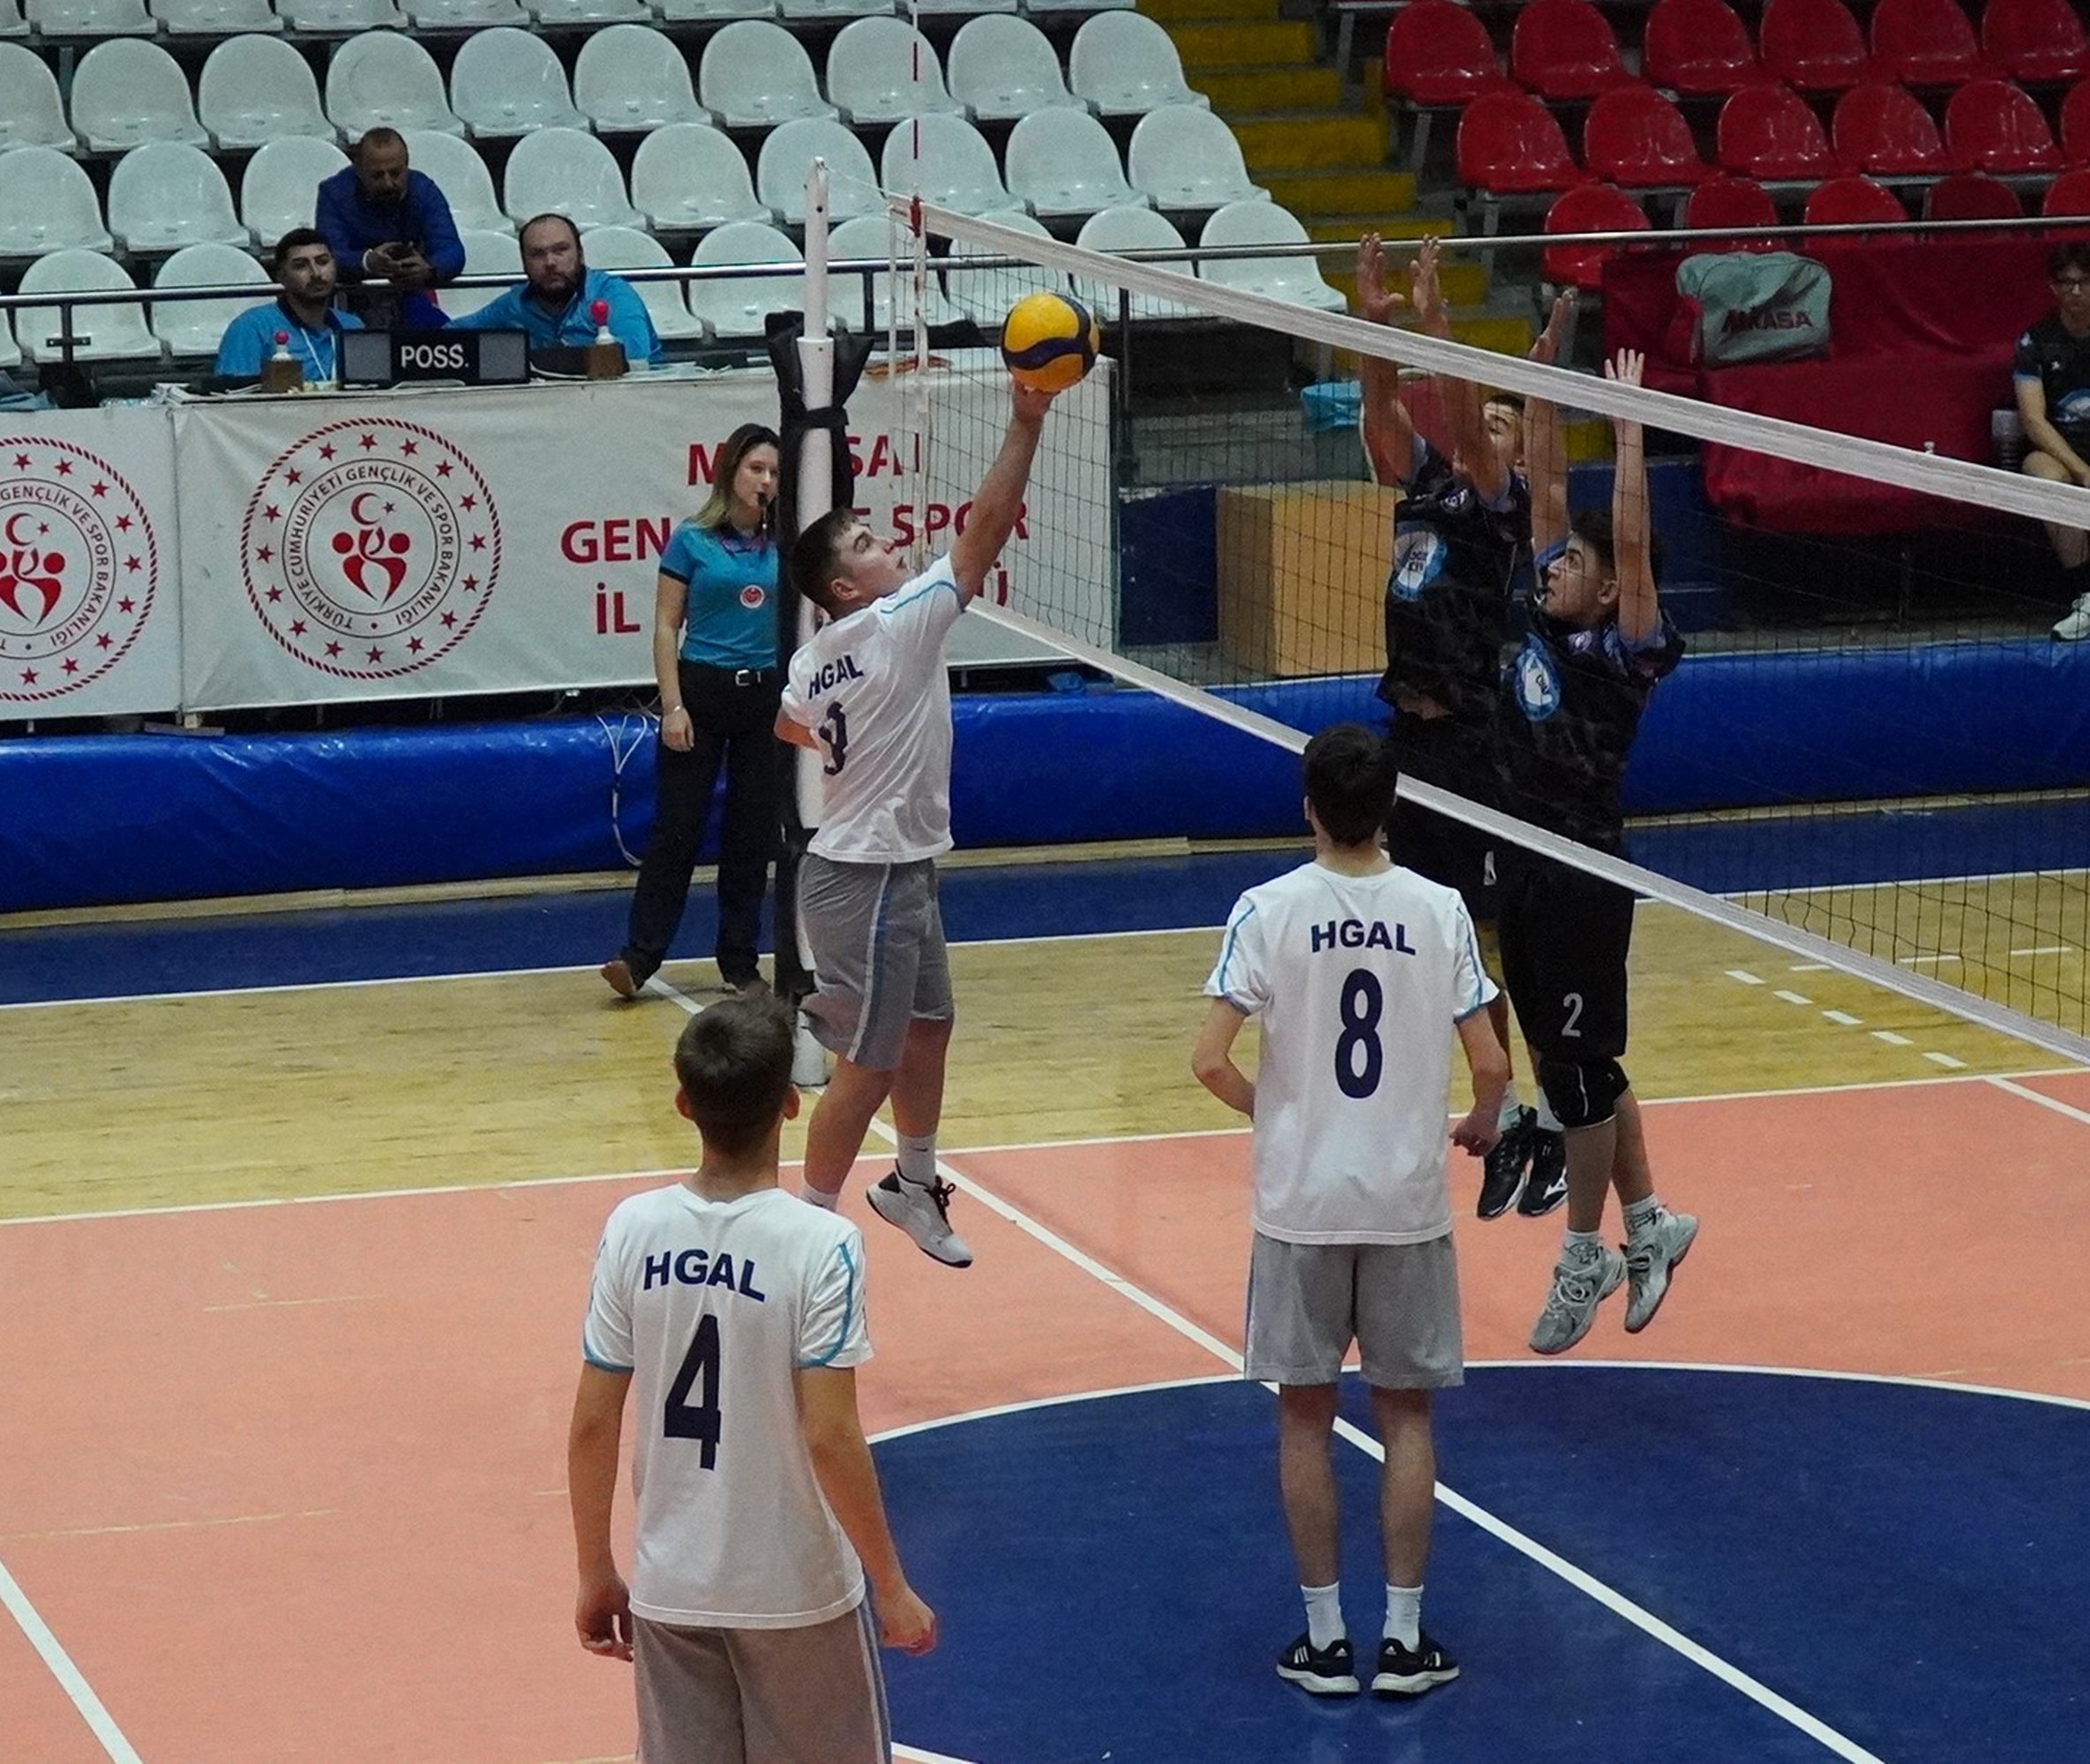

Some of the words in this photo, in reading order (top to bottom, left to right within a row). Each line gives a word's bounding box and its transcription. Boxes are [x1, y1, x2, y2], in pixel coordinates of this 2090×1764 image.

[401, 343, 469, 369] POSS.
[1, 485, 71, 509] GENÇLİK
[346, 466, 416, 488] GENÇLİK
[416, 484, 436, 504] VE
[72, 503, 91, 524] VE
[289, 472, 342, 576] CUMHURİYETİ
[431, 503, 453, 545] SPOR
[86, 524, 109, 566] SPOR
[50, 572, 109, 647] BAKANLIĞI
[296, 579, 353, 630] TÜRKİYE
[395, 551, 453, 625] BAKANLIĞI
[596, 582, 640, 634] İL
[808, 655, 864, 699] HGAL
[1311, 919, 1416, 956] HGAL
[1335, 968, 1383, 1099] 8
[1562, 992, 1584, 1037] 2
[643, 1249, 766, 1303] HGAL
[663, 1313, 722, 1471] 4
